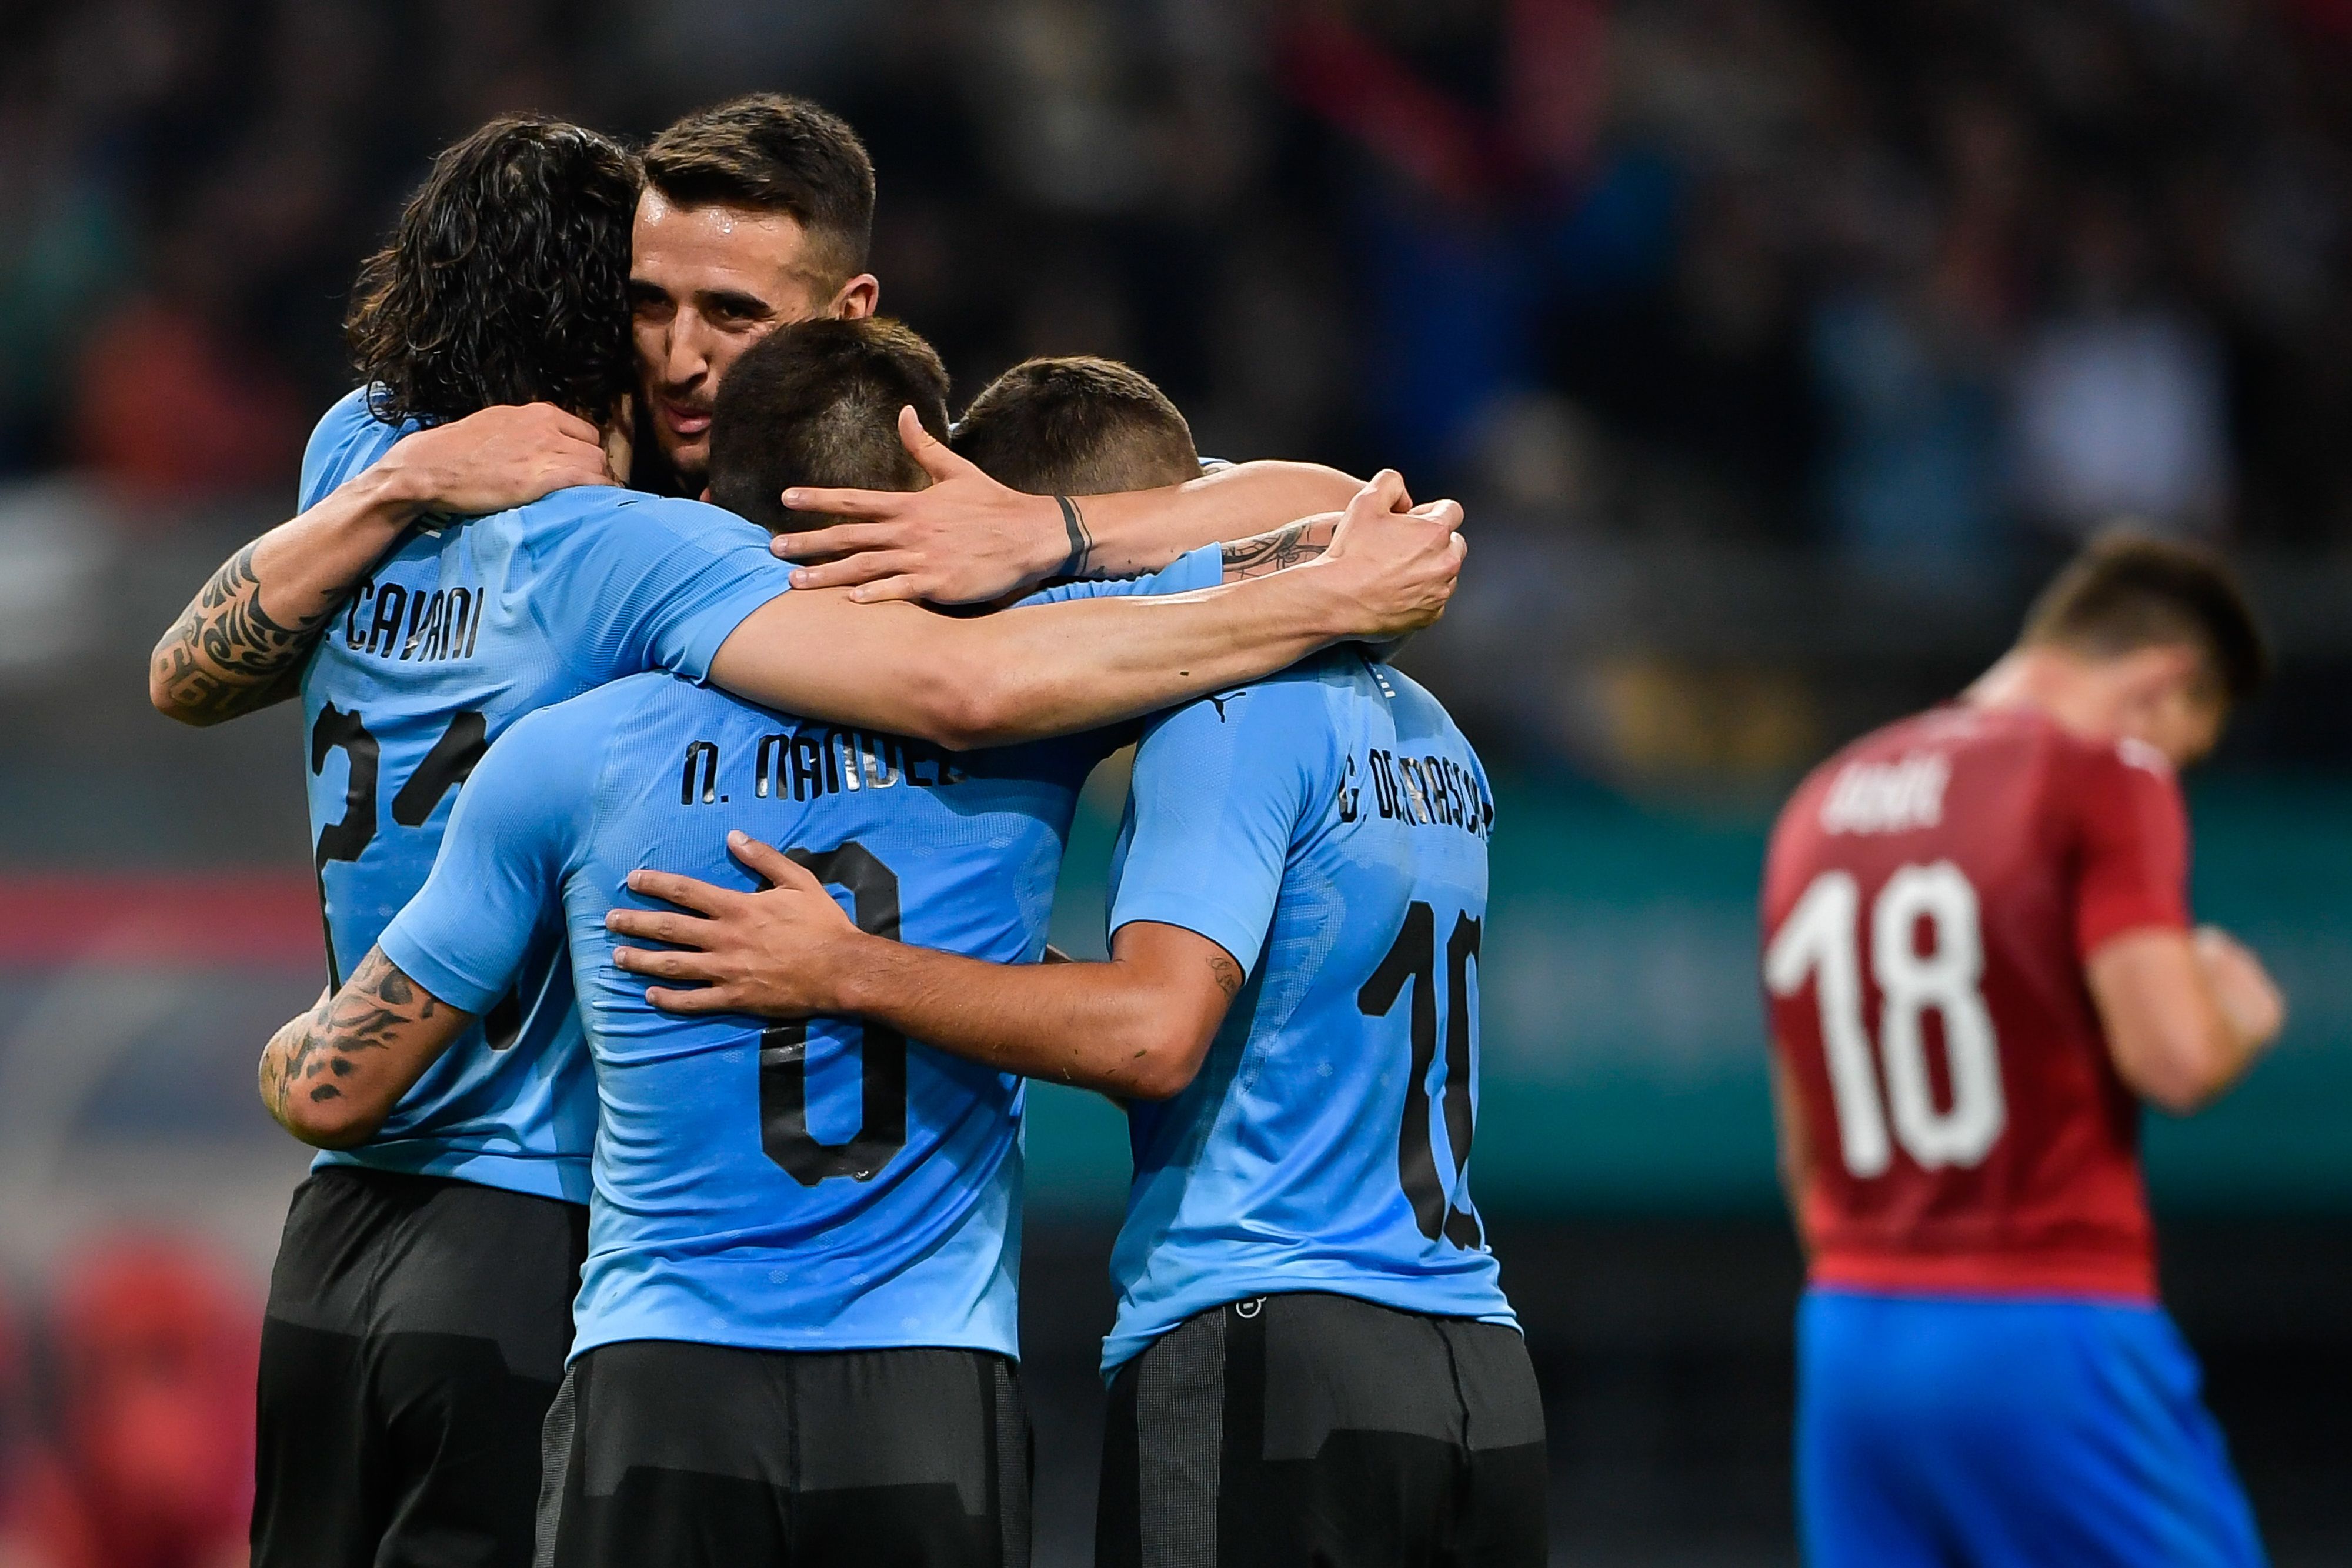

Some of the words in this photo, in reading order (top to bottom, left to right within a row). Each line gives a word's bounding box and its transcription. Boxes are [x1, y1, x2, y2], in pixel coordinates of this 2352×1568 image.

[346, 578, 484, 662] CAVANI
[680, 740, 729, 805] N.
[1356, 900, 1485, 1252] 10
[1766, 860, 2008, 1179] 18
